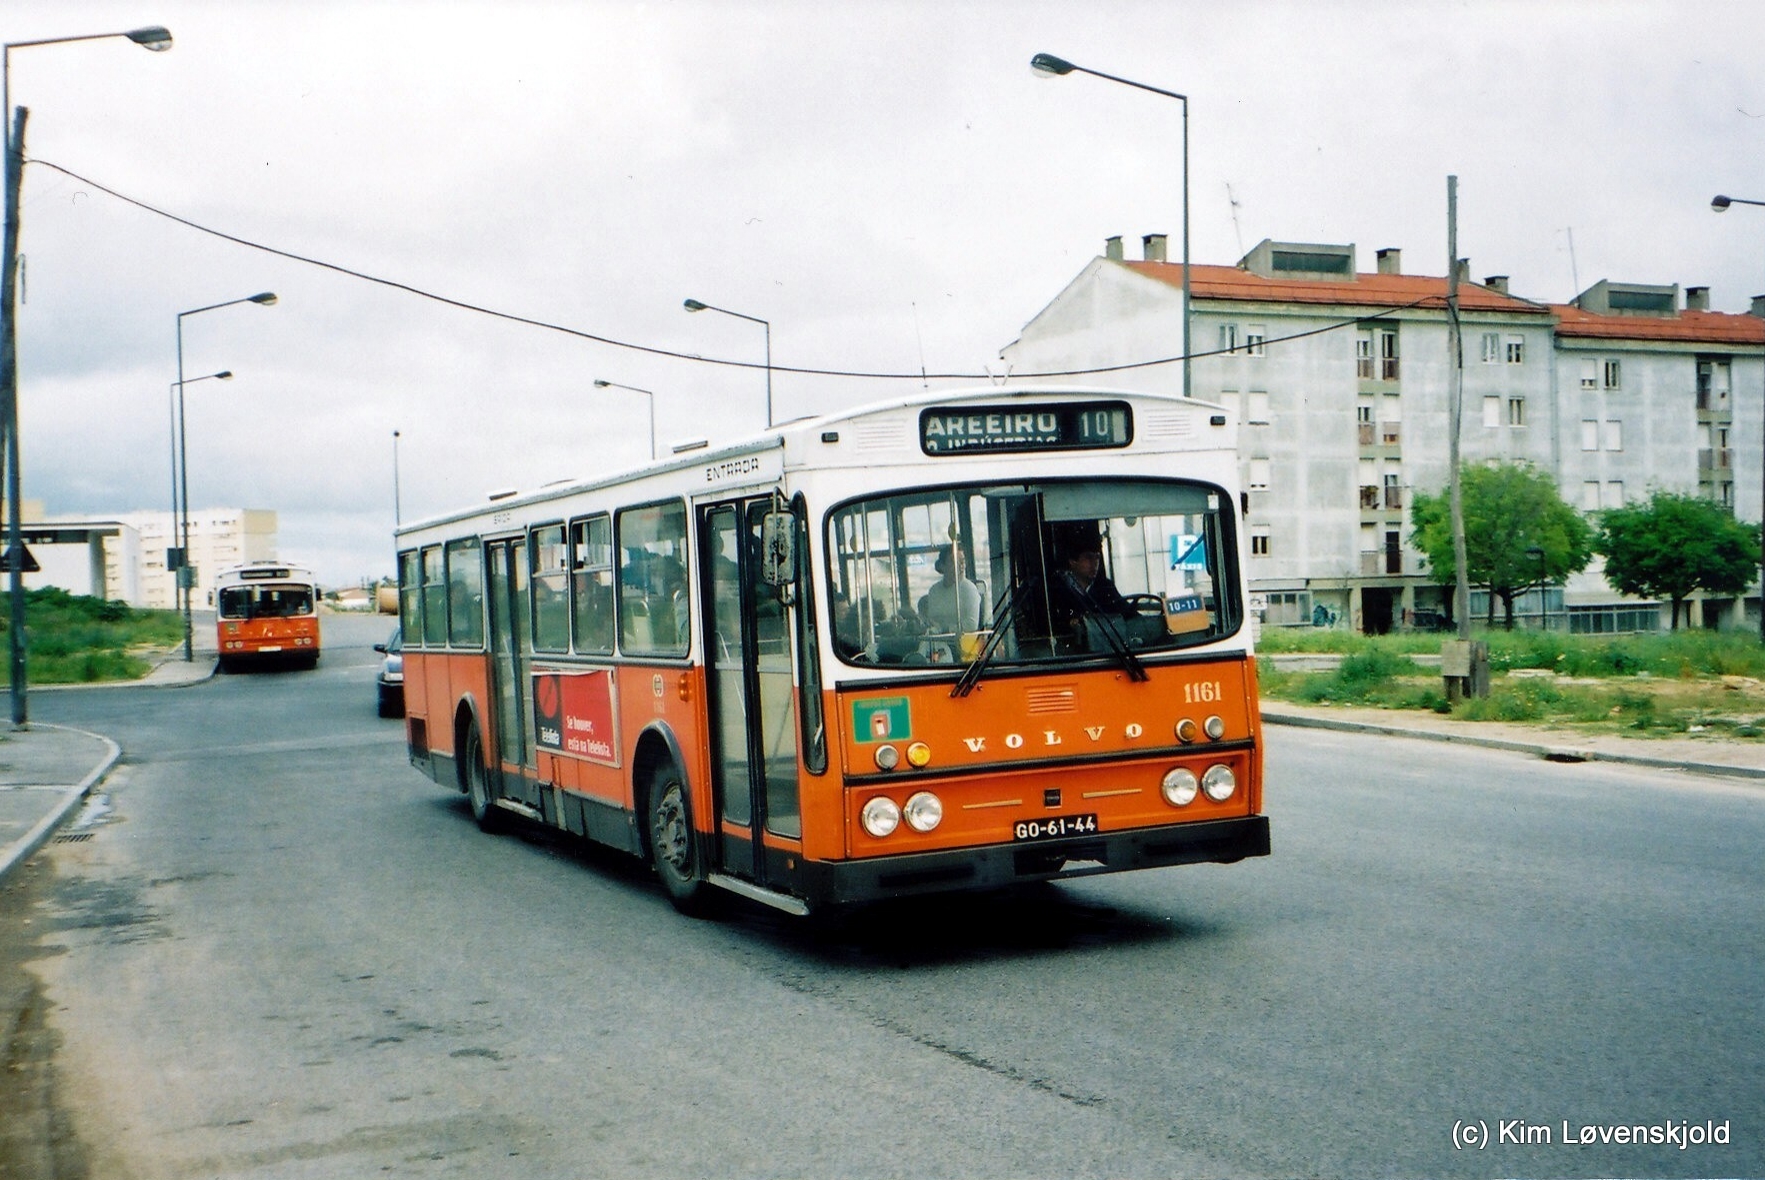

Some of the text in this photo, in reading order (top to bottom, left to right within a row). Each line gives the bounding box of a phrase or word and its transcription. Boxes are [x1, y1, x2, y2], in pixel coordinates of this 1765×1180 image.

[926, 411, 1108, 437] AREEIRO 10
[706, 457, 759, 481] ENTRADA
[1169, 599, 1198, 611] 10-11
[1184, 681, 1222, 703] 1161
[566, 715, 573, 729] Se
[963, 723, 1143, 753] VOLVO
[1016, 816, 1096, 839] GO-61-44
